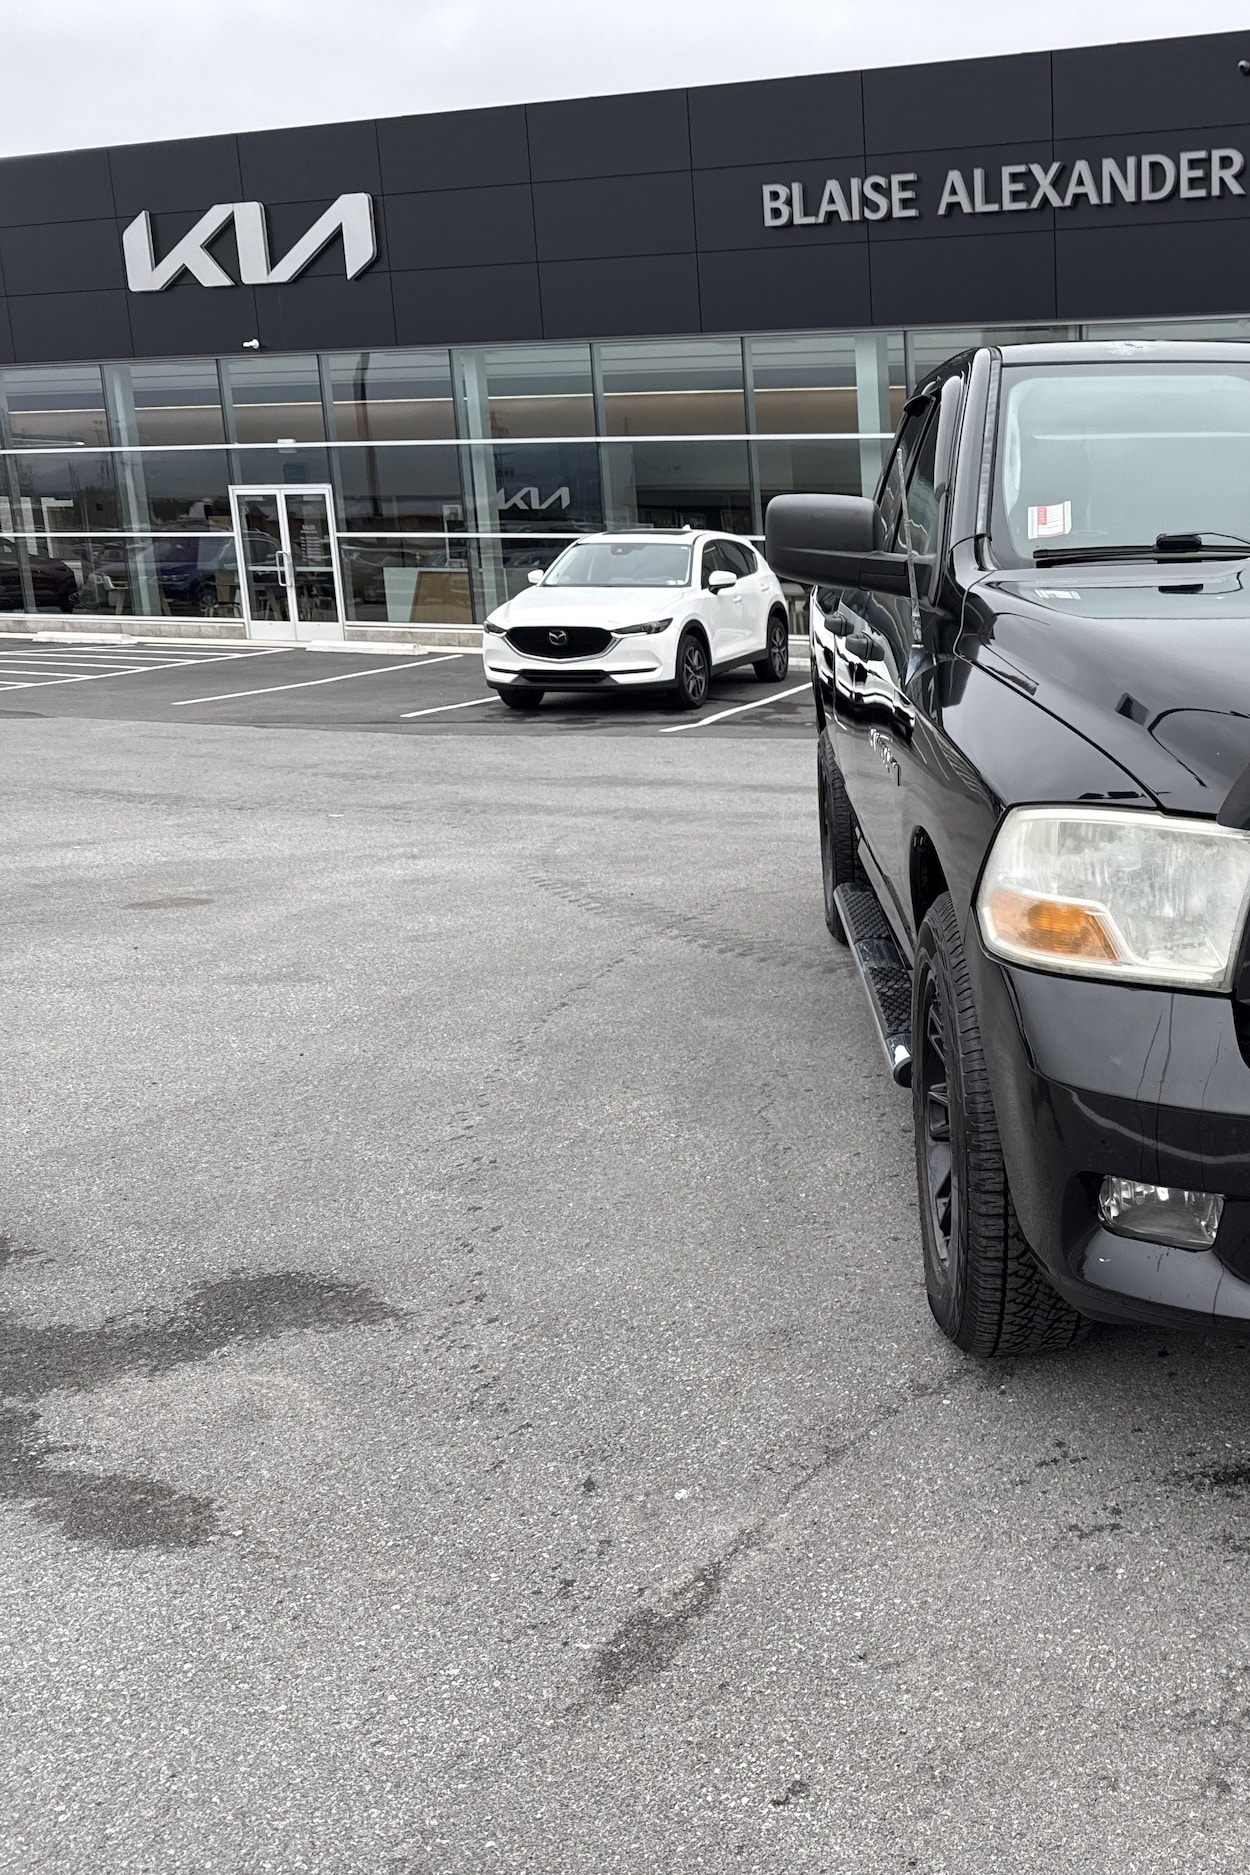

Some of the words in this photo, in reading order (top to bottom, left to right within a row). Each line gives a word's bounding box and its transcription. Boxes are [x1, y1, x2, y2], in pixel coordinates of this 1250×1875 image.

[761, 171, 920, 228] BLAISE
[936, 147, 1246, 216] ALEXANDER
[122, 191, 377, 292] KIA
[496, 486, 571, 510] KIA
